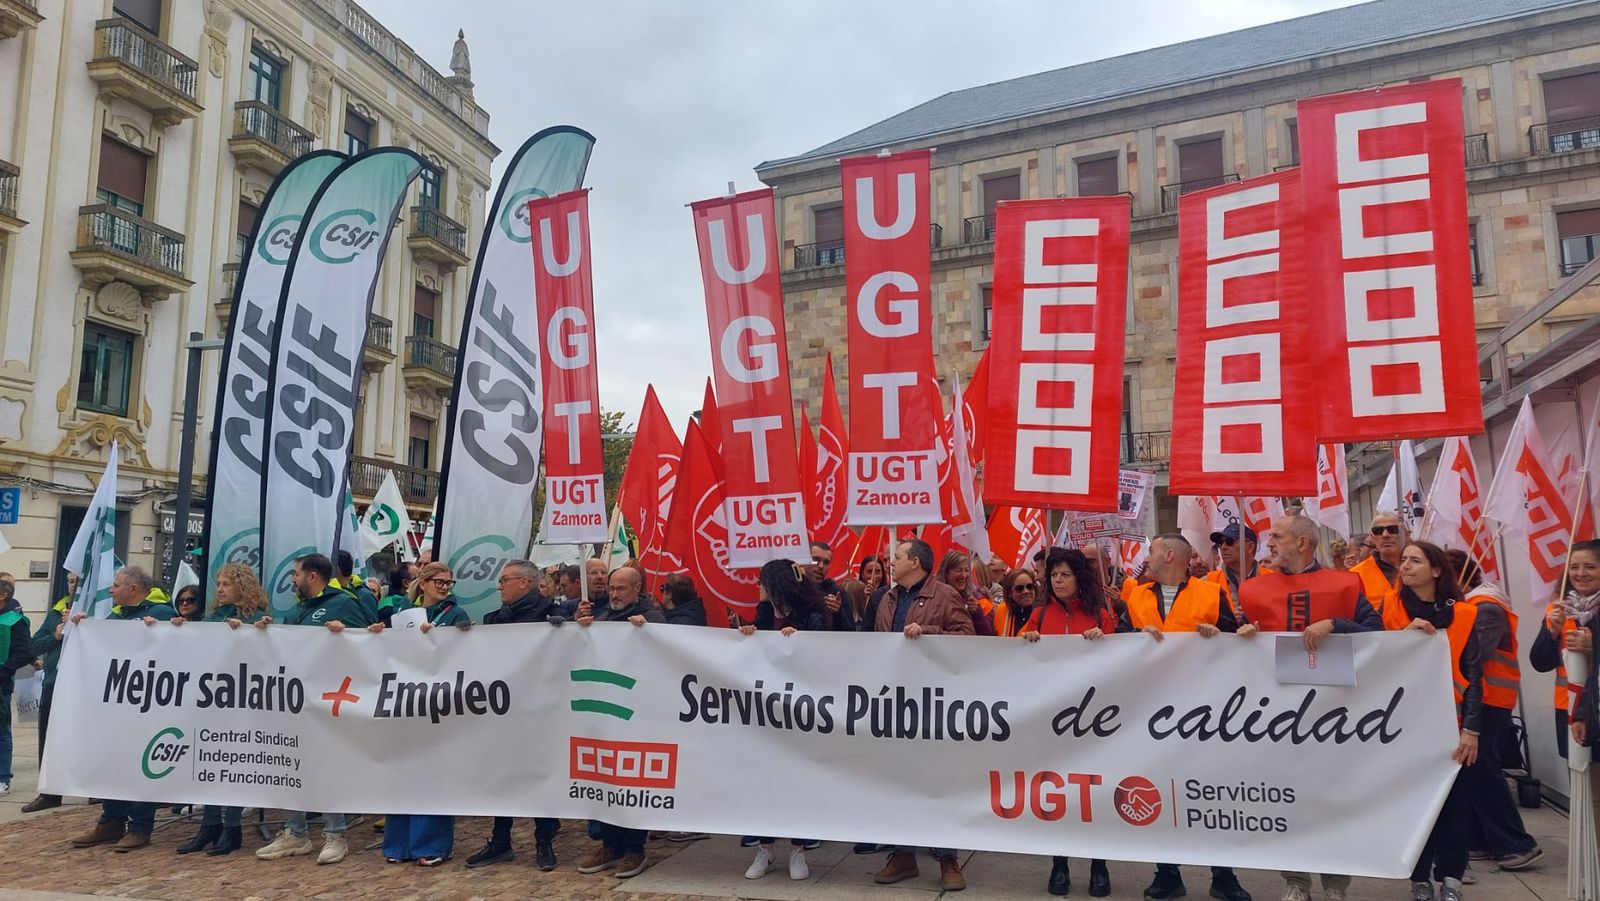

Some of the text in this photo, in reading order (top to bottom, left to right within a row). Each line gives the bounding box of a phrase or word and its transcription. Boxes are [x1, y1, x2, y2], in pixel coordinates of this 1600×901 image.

[270, 228, 294, 249] CS
[325, 223, 379, 251] CSIF
[1335, 101, 1446, 418] CCOO
[855, 172, 919, 441] UGT
[540, 211, 591, 465] UGT
[1201, 183, 1285, 473] CCOO
[708, 213, 782, 484] UGT
[1014, 218, 1100, 495] CCOO
[274, 302, 353, 498] CSIF
[856, 454, 929, 483] UGT
[551, 478, 599, 505] UGT
[857, 488, 931, 507] Zamora
[163, 517, 204, 534] CADOS
[552, 508, 602, 527] Zamora
[733, 497, 797, 527] UGT
[1216, 499, 1240, 525] Leó
[736, 530, 801, 549] Zamora
[227, 545, 260, 568] CS
[456, 555, 502, 581] CSI
[102, 658, 191, 714] Mejor
[196, 662, 304, 715] salario
[373, 670, 510, 724] Empleo
[679, 673, 834, 735] Servicios
[846, 685, 1011, 742] Públicos
[1052, 686, 1121, 738] de
[1147, 686, 1405, 745] calidad
[150, 740, 189, 762] CSIF
[199, 728, 299, 749] Central Sindical
[199, 749, 301, 772] Independiente y
[577, 746, 669, 779] CCOO
[198, 768, 302, 789] de Funcionarios
[1186, 779, 1296, 804] Servicios
[569, 781, 675, 810] área pública
[988, 769, 1103, 824] UGT
[1187, 807, 1288, 833] Públicos
